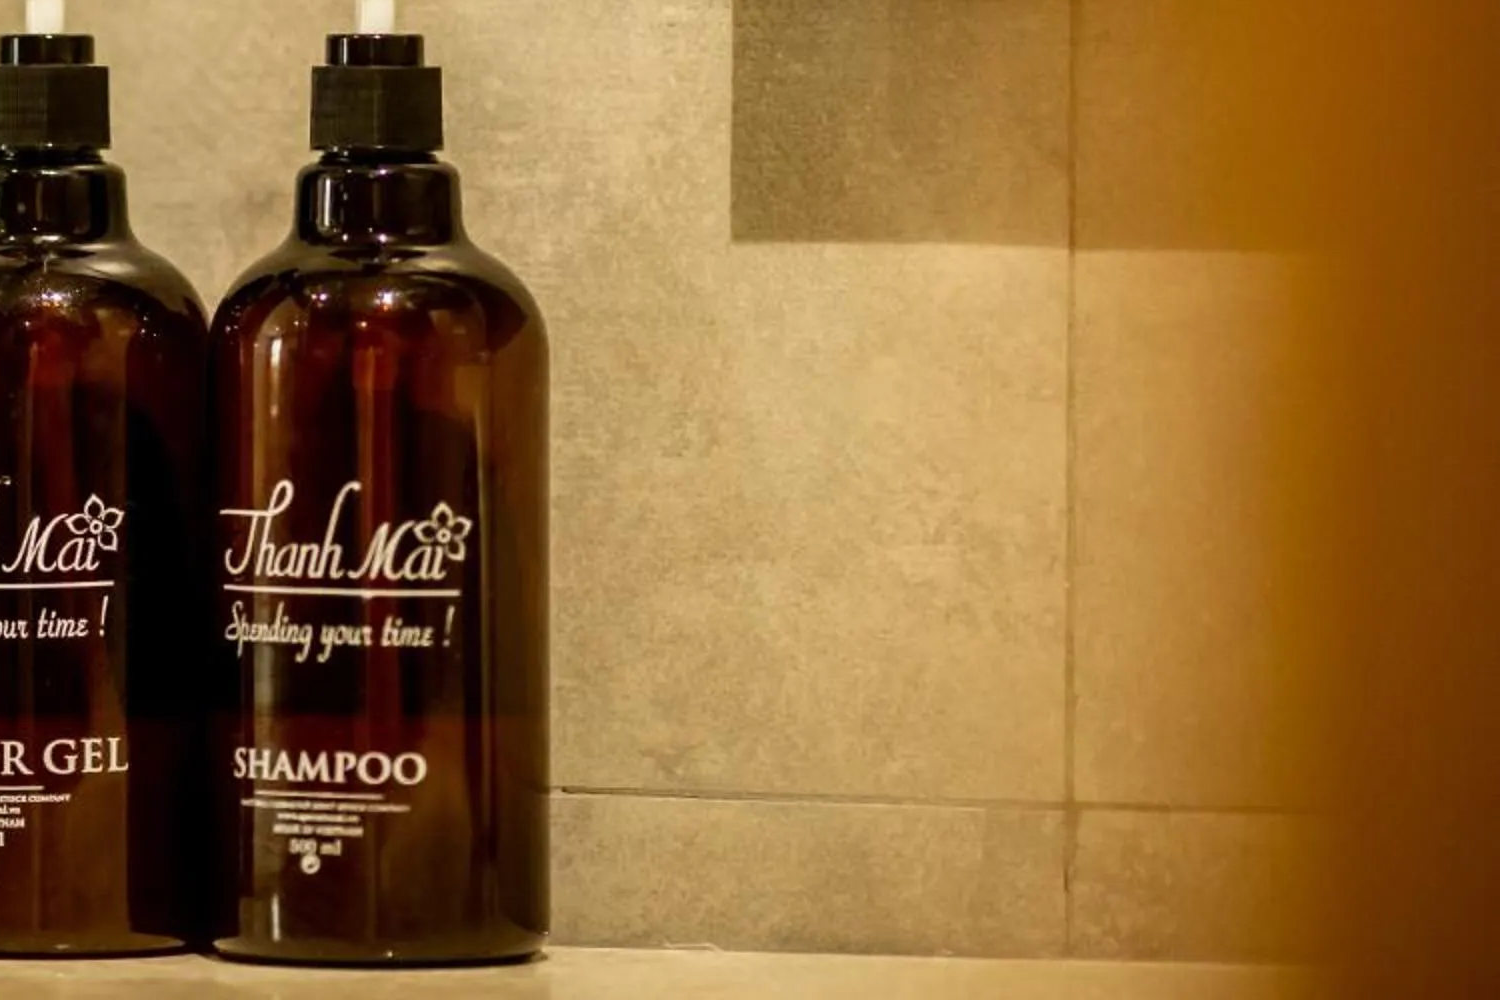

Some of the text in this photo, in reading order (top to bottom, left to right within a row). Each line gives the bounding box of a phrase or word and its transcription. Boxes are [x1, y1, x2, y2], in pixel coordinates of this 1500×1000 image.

[1, 512, 100, 573] Mai
[219, 479, 449, 581] Thanh Mai
[37, 607, 89, 639] time
[225, 600, 313, 664] Spending
[319, 621, 372, 664] your
[380, 614, 434, 648] time
[42, 736, 129, 775] GEL
[233, 746, 427, 786] SHAMPOO
